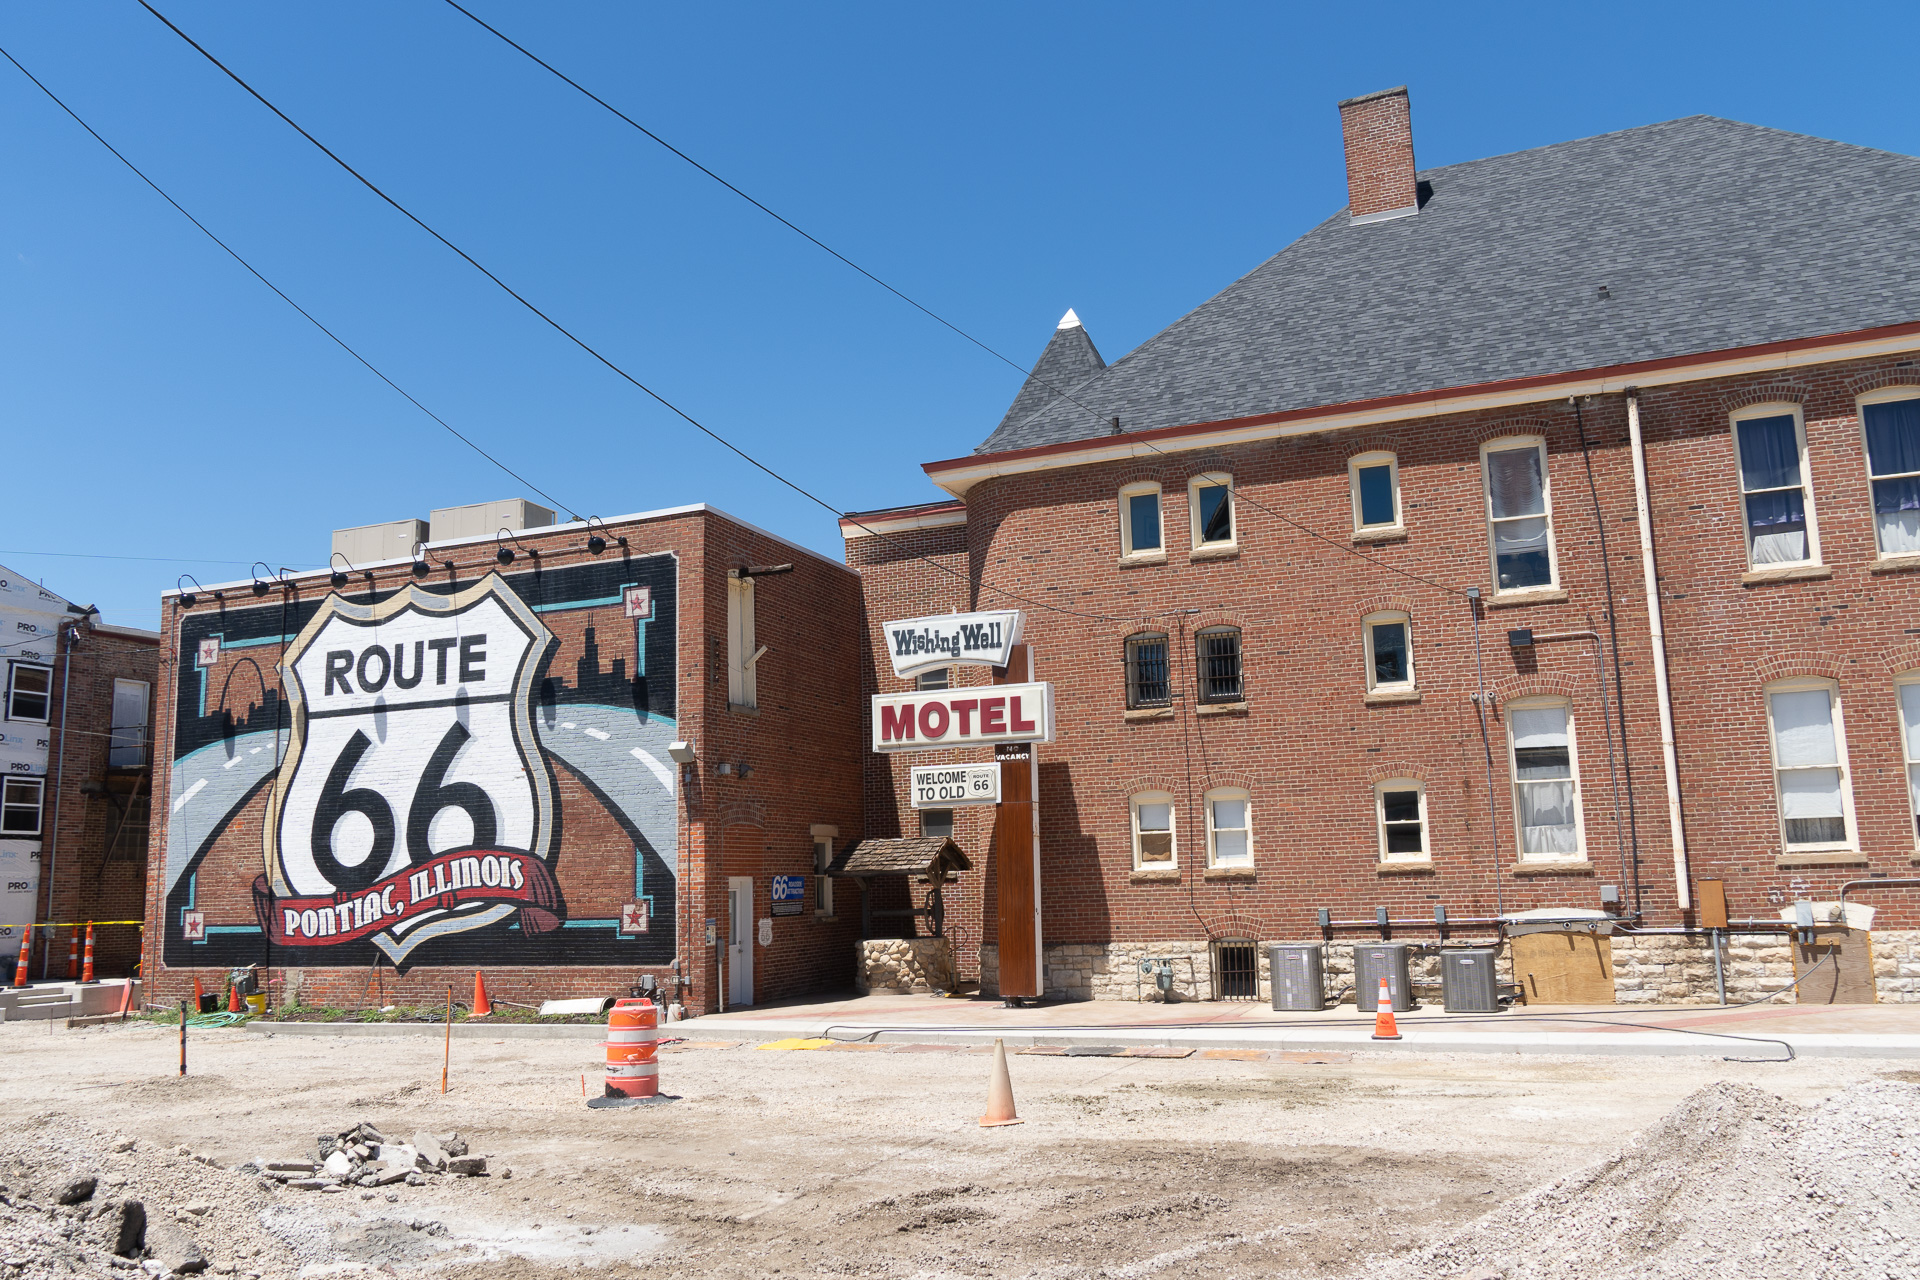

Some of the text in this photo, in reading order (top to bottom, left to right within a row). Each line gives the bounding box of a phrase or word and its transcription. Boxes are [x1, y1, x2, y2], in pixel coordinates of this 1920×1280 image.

[892, 622, 1003, 657] Wishing Well
[324, 633, 487, 696] ROUTE
[881, 696, 1035, 741] MOTEL
[916, 771, 966, 785] WELCOME
[918, 786, 965, 800] TO OLD
[973, 780, 989, 791] 66
[311, 720, 498, 892] 66
[409, 855, 525, 905] ILLINOIS
[772, 875, 788, 899] 66
